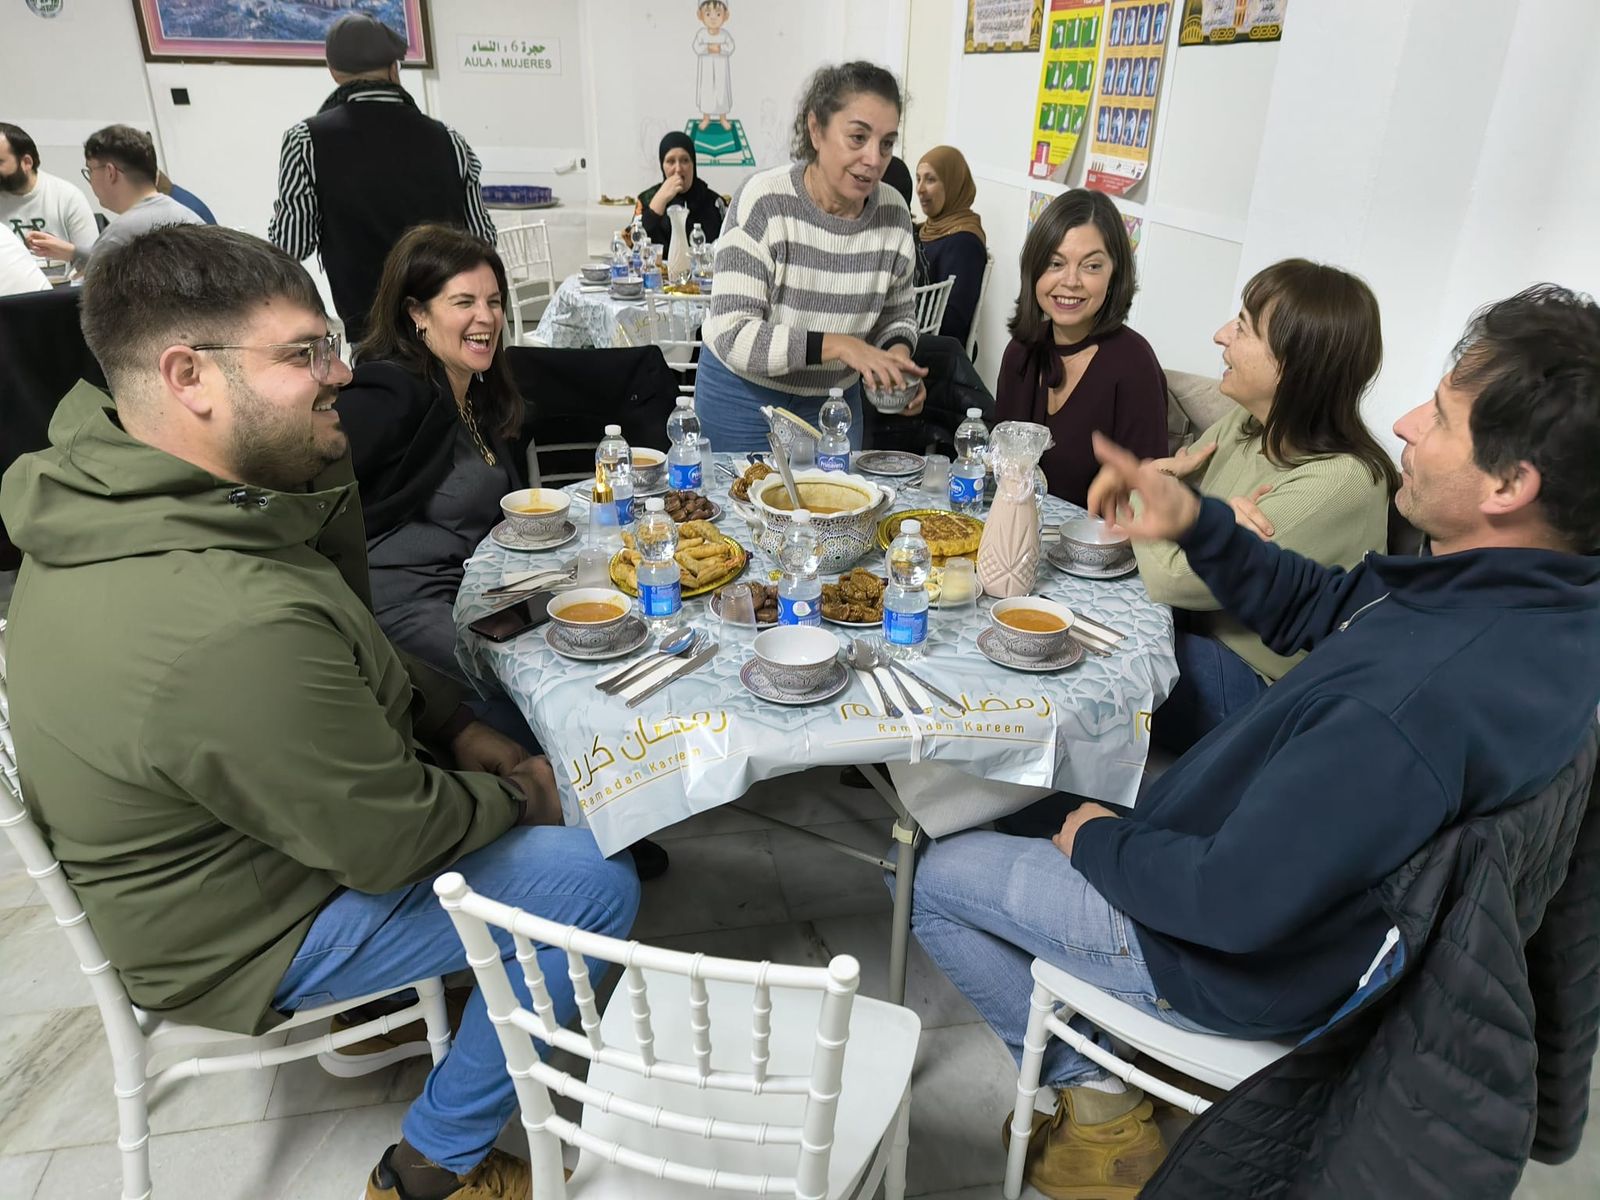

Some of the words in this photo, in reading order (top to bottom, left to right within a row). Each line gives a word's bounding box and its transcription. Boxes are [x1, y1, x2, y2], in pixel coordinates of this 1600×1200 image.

[511, 40, 519, 52] 6
[522, 41, 546, 56] حجرة
[501, 58, 552, 69] MUJERES
[964, 721, 1025, 734] Kareem
[579, 771, 642, 810] Ramadan
